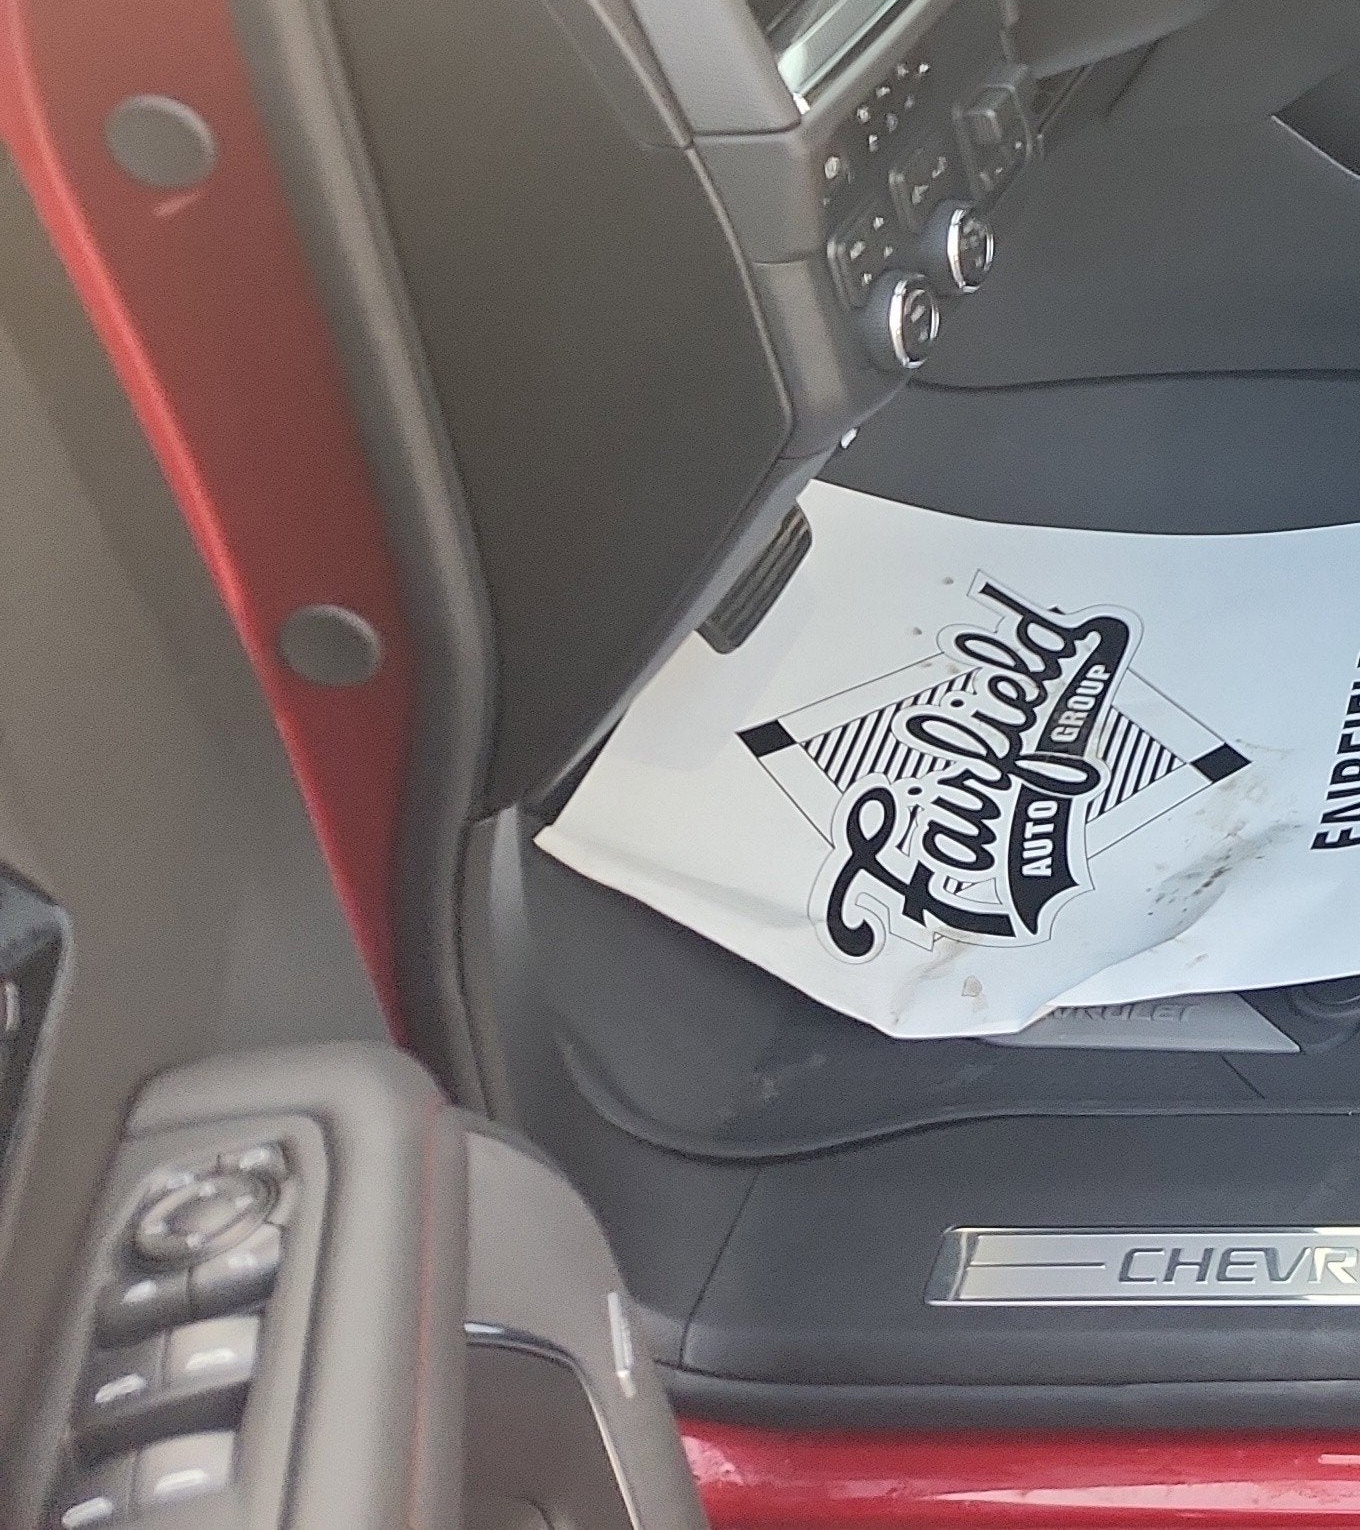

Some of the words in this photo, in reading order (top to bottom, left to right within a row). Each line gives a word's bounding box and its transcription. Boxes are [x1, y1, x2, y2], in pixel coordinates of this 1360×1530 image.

[827, 582, 1130, 958] Fairfield
[1021, 800, 1059, 878] AUTO
[1051, 664, 1106, 743] GROUP
